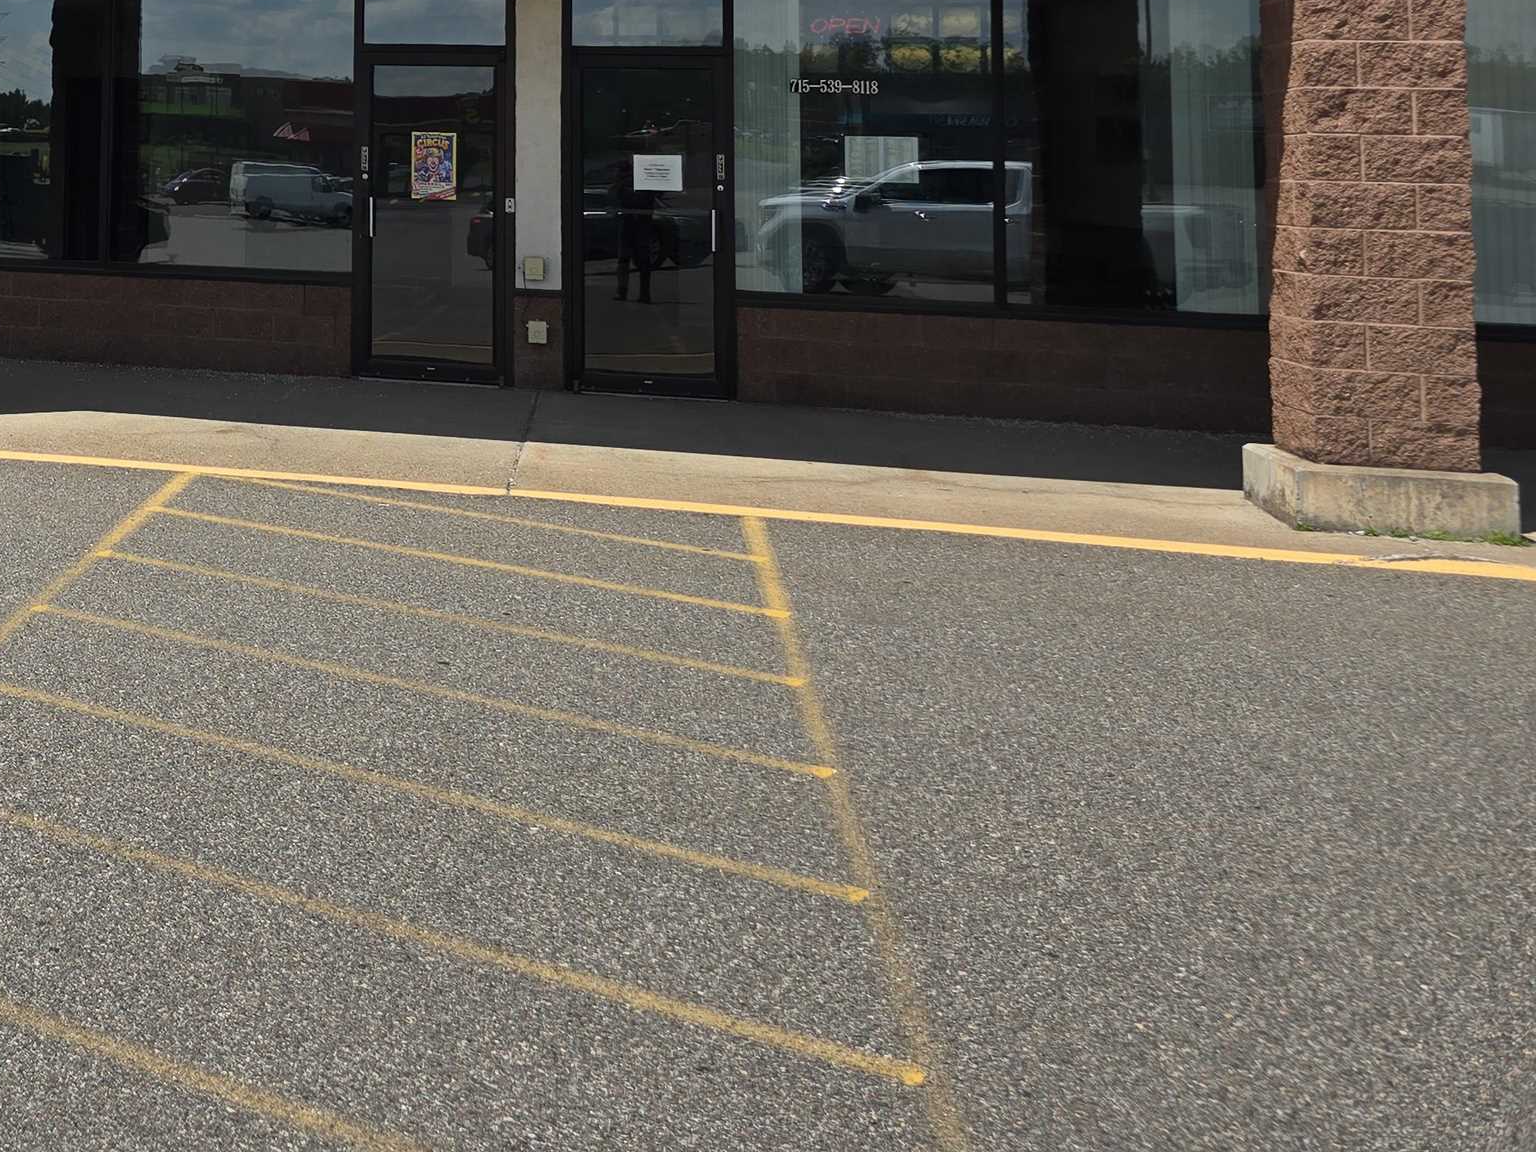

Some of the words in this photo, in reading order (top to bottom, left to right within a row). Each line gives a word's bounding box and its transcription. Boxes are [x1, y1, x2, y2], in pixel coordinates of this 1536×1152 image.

[810, 17, 880, 35] OPEN
[790, 79, 879, 94] 715-539-8118
[416, 138, 450, 149] CIRCUS
